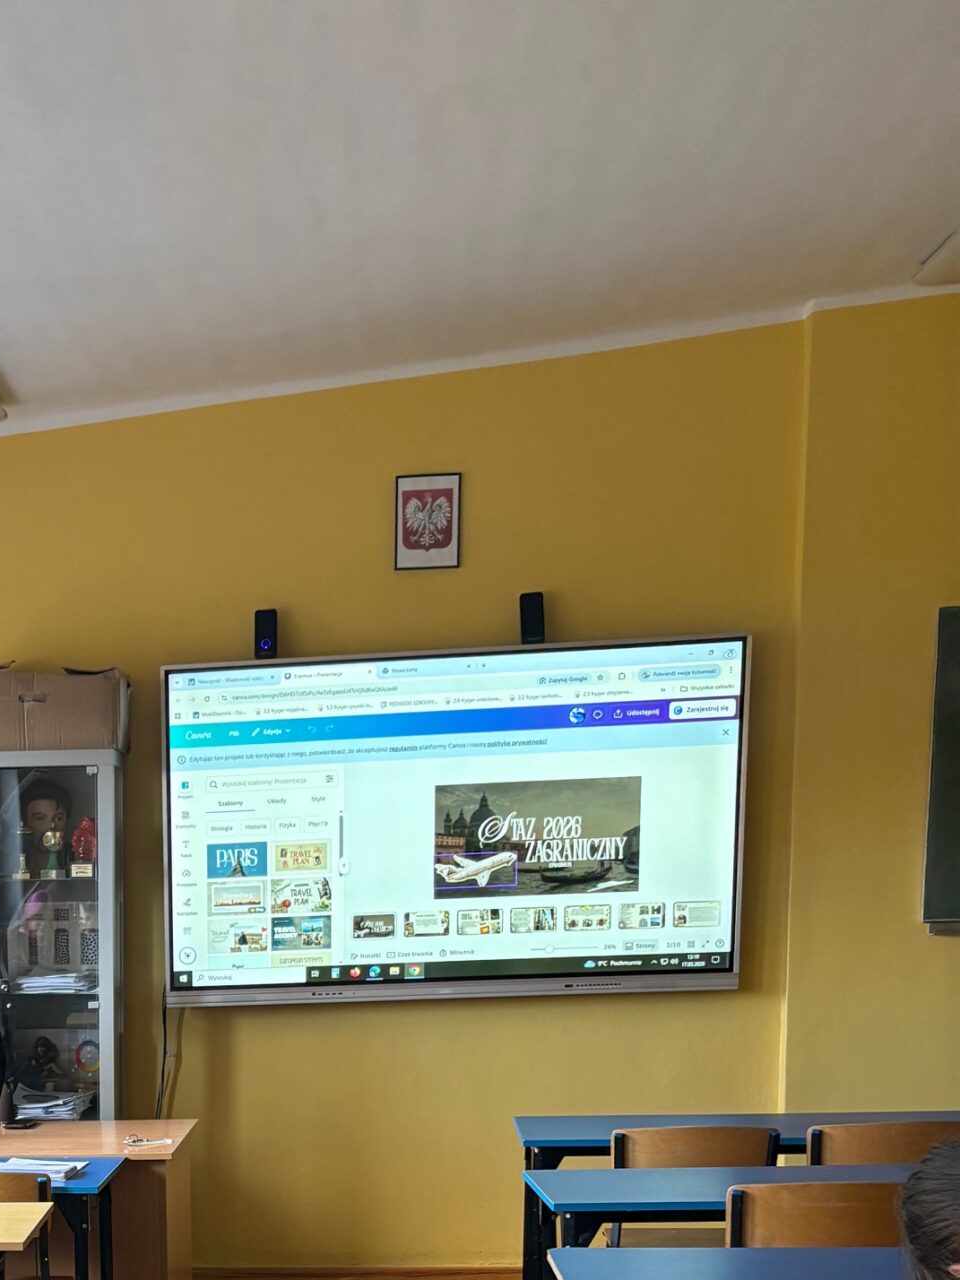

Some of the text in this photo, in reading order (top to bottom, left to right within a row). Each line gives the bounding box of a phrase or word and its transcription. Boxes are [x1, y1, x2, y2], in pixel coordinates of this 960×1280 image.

[626, 708, 660, 718] Udostępnij
[686, 704, 729, 714] Zarejestruj się
[186, 730, 212, 741] Canva
[263, 728, 282, 736] Edycja
[255, 752, 286, 760] korzystając
[388, 745, 418, 753] regulamin
[418, 743, 447, 751] platformy
[487, 740, 510, 748] politykę
[512, 738, 548, 748] prywatności
[274, 776, 307, 784] Prezentacja
[543, 816, 582, 840] 2026
[290, 850, 313, 858] TRAVEL
[524, 837, 628, 864] ZAGRANICZNY
[216, 848, 258, 868] PARIS
[292, 857, 310, 866] PLAN
[290, 888, 312, 898] TRAVEL
